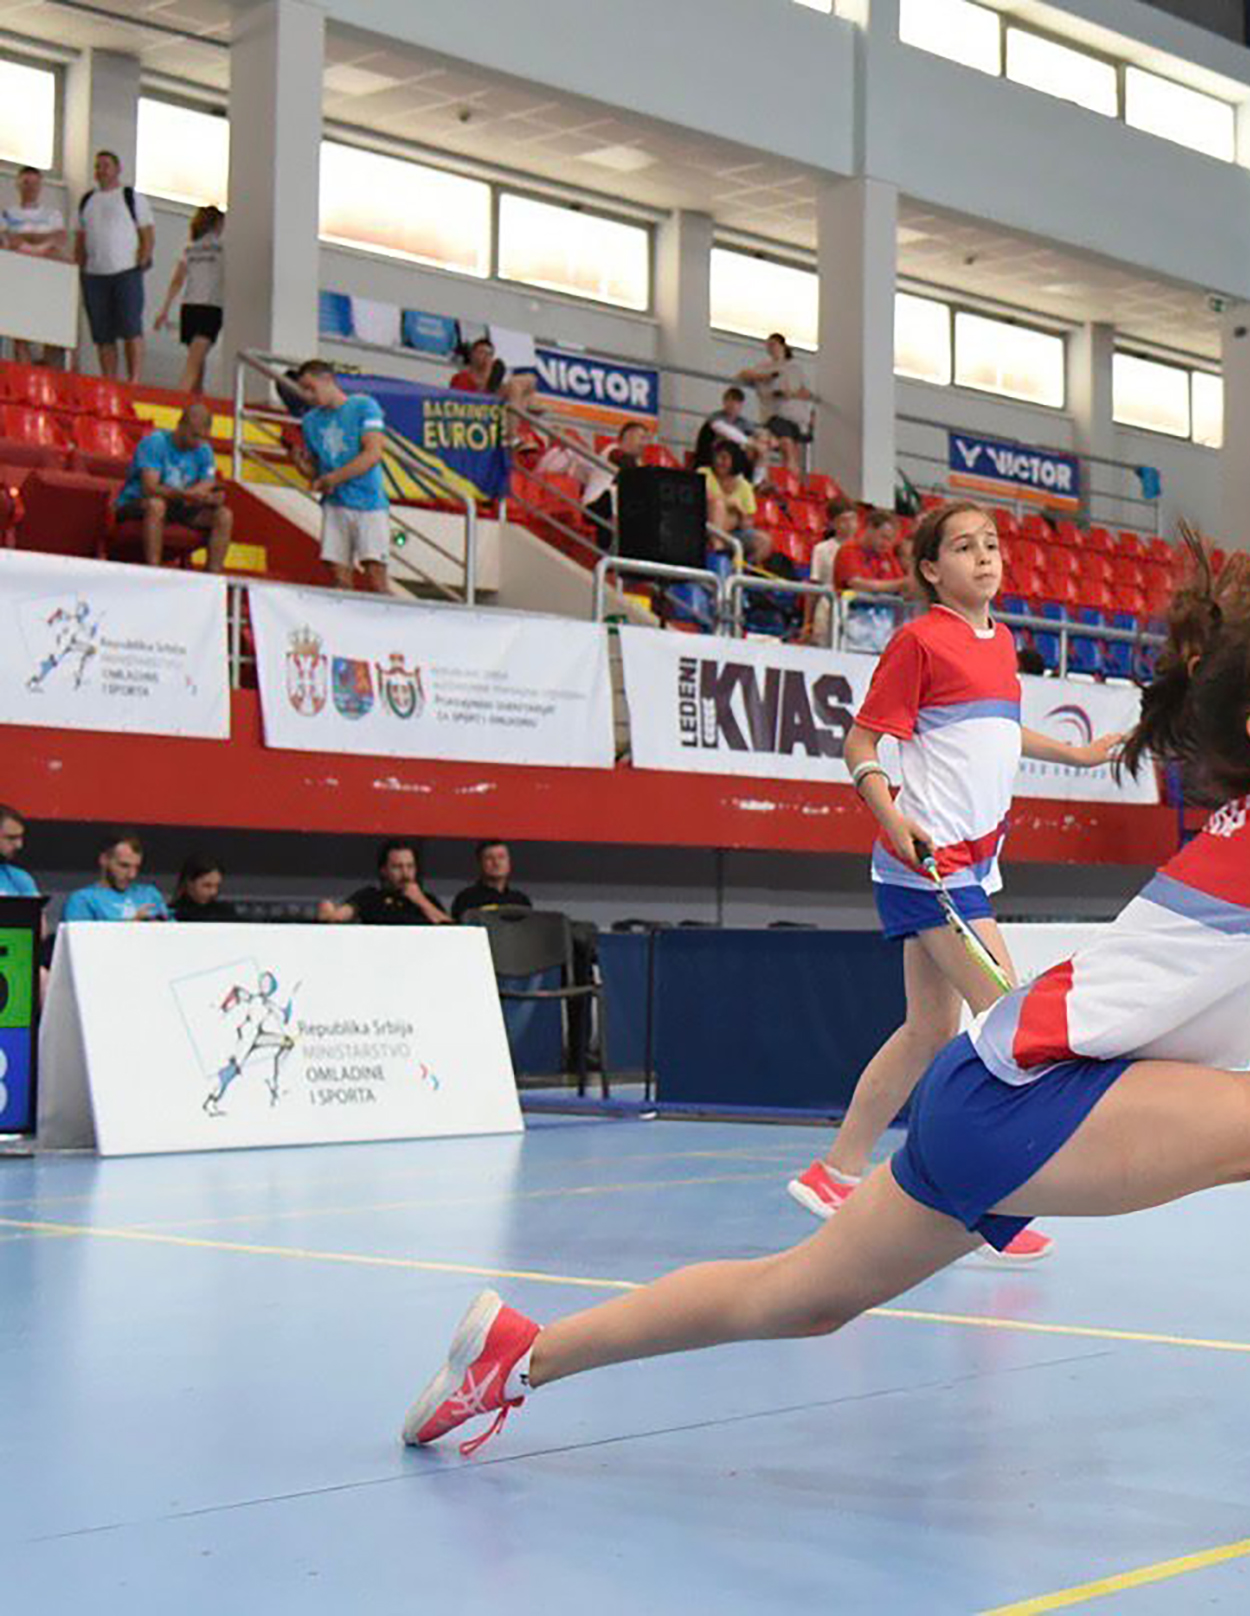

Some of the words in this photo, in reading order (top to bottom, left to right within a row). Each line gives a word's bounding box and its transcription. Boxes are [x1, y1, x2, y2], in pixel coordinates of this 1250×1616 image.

[534, 356, 650, 408] VICTOR
[985, 446, 1072, 491] VICTOR
[679, 656, 698, 748] LEDENI
[700, 659, 856, 759] KVAS
[297, 1018, 370, 1038] Republika
[372, 1018, 414, 1038] Srbija
[302, 1042, 411, 1060] MINISTARSTVO
[305, 1065, 387, 1083] OMLADINE
[317, 1088, 378, 1106] SPORTA
